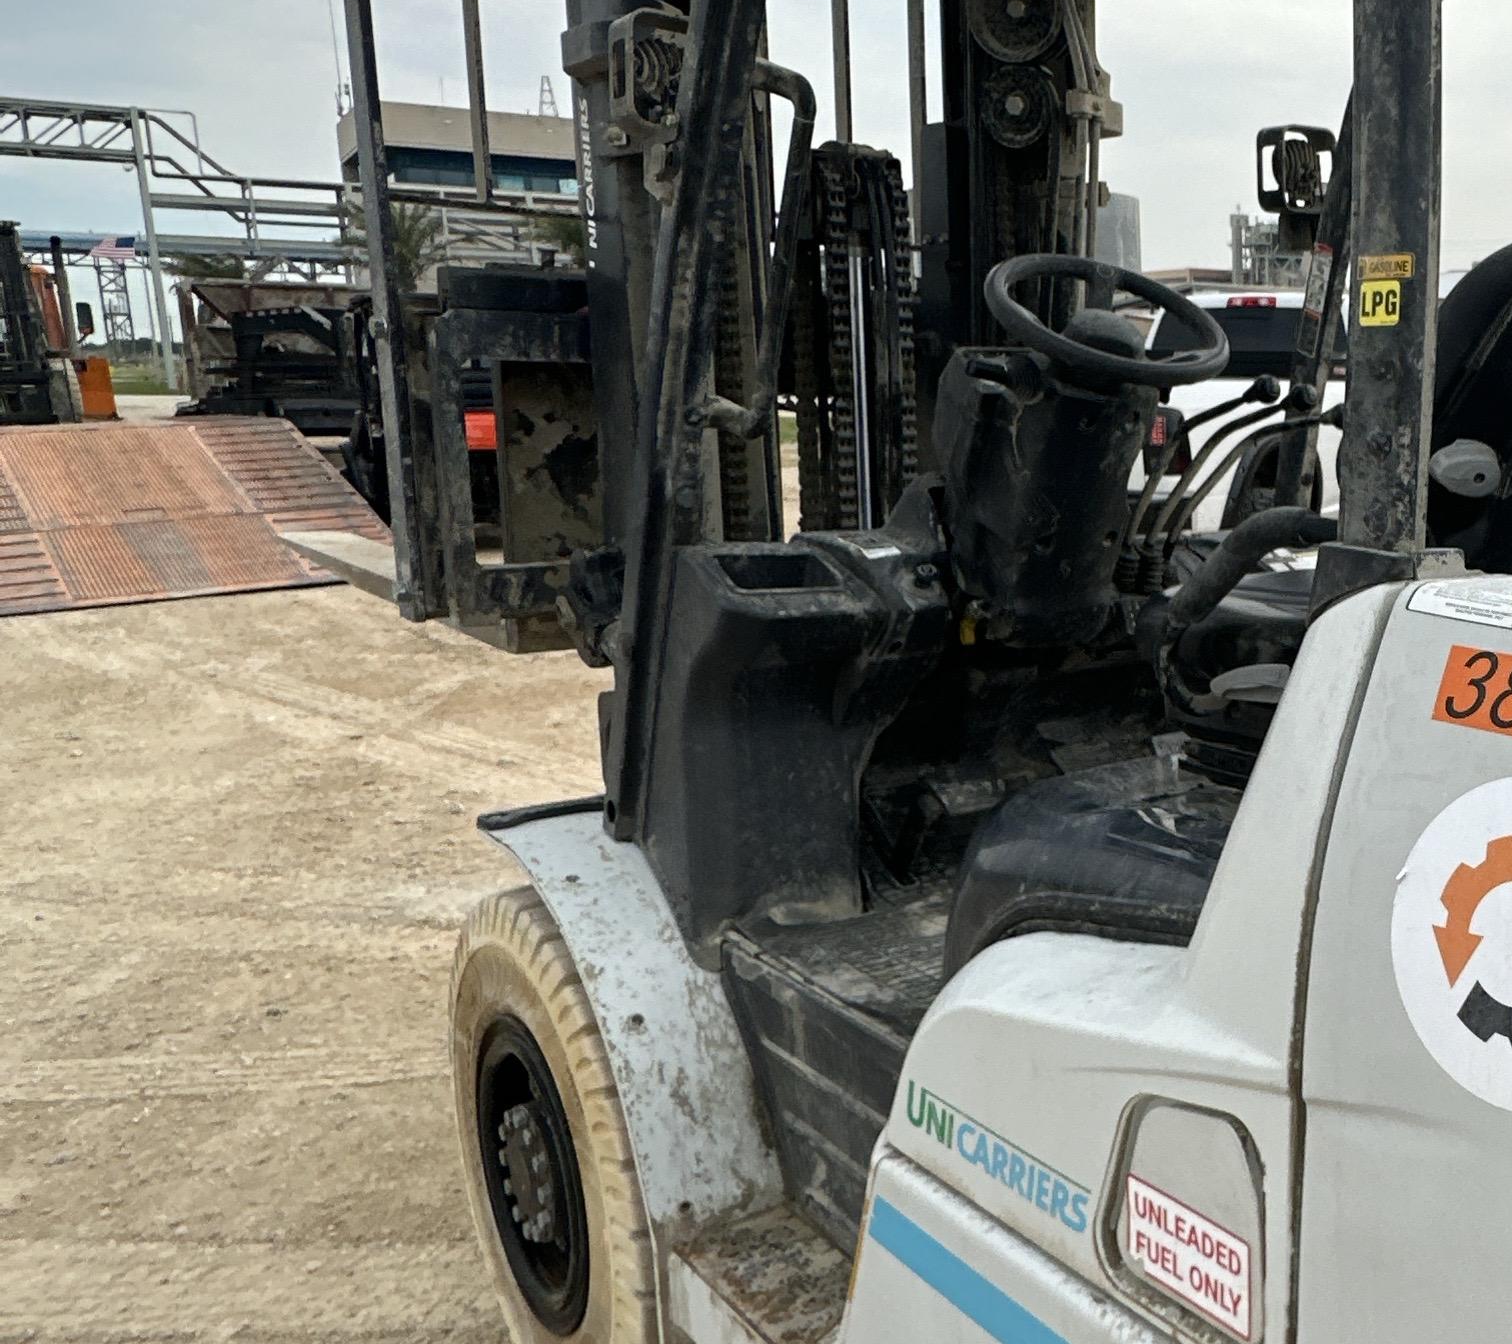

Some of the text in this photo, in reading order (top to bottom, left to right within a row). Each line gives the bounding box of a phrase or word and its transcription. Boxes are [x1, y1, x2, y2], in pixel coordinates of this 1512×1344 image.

[577, 96, 599, 269] NICARRIERS
[1361, 289, 1397, 317] LPG
[1369, 260, 1409, 272] GASOLINE
[906, 1079, 1092, 1234] UNICARRIERS
[1134, 1190, 1242, 1277] UNLEADED
[1135, 1232, 1243, 1319] FUEL ONLY
